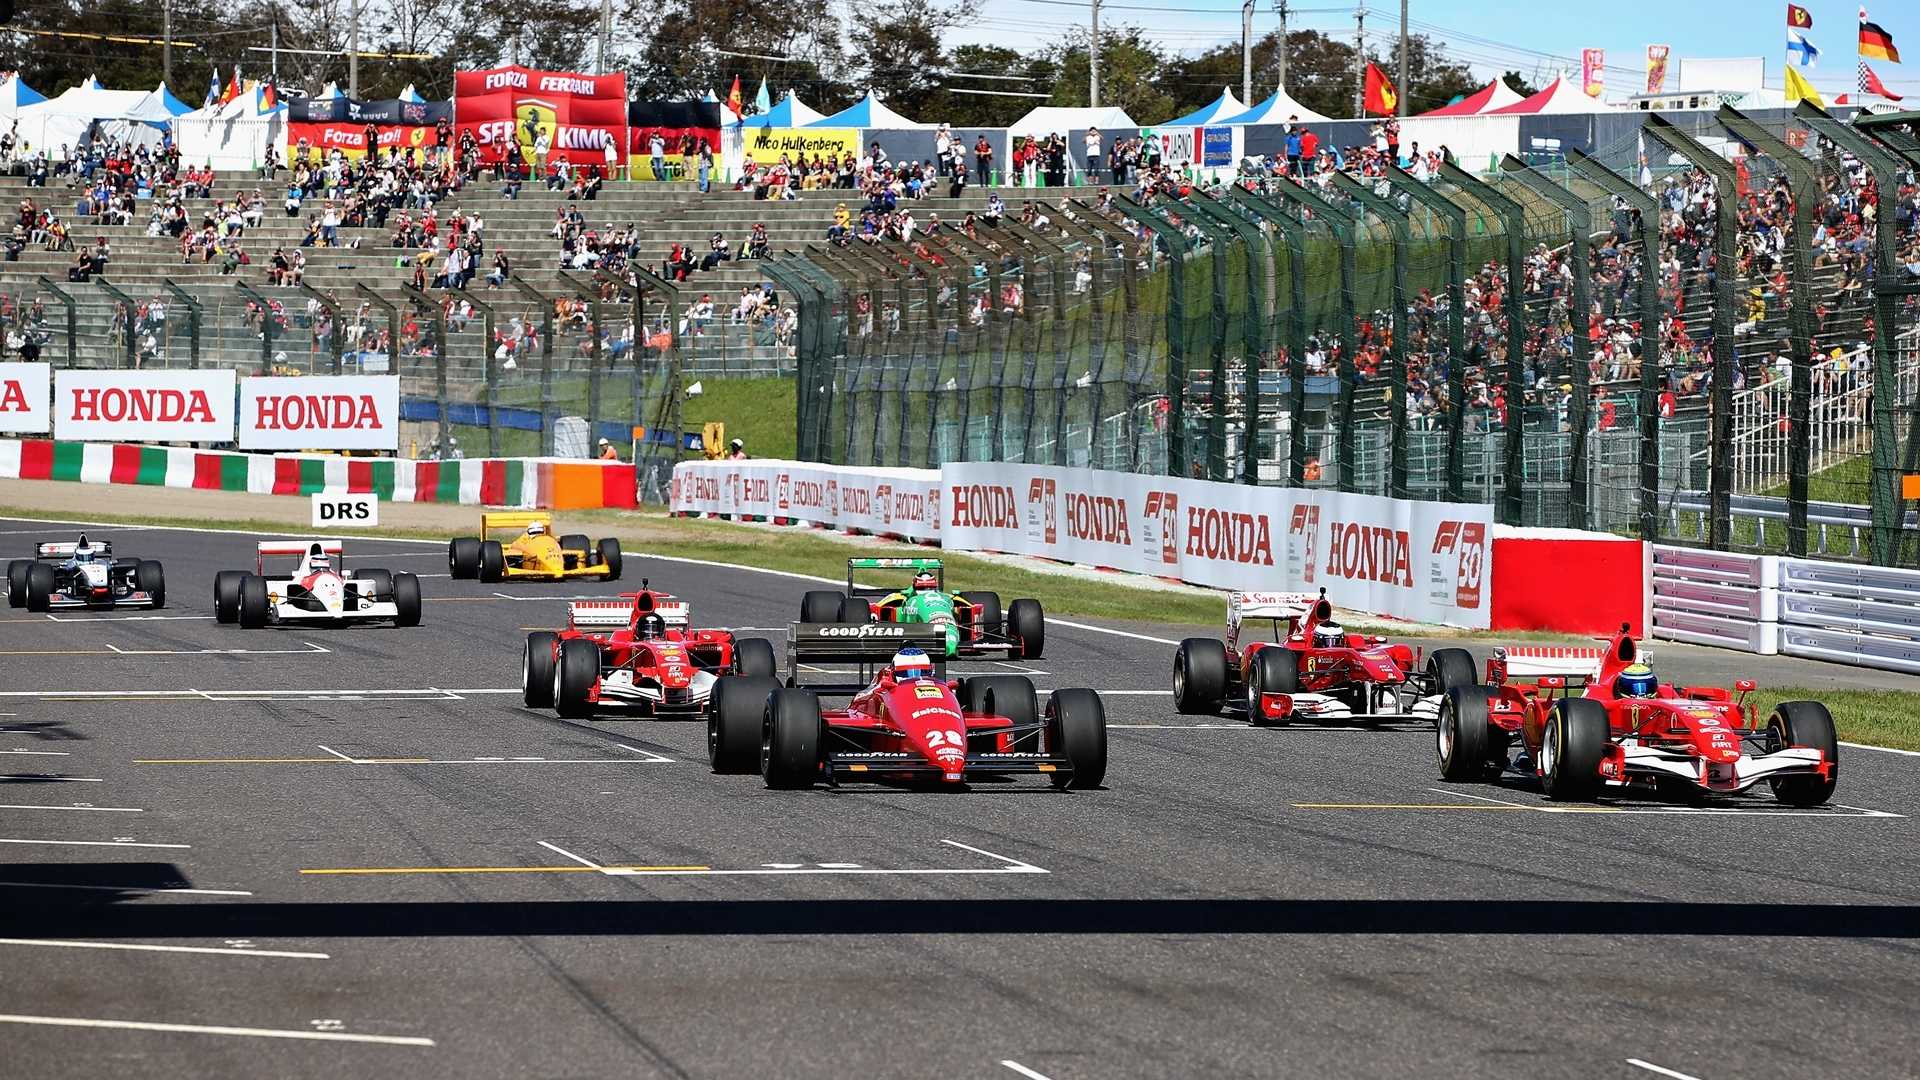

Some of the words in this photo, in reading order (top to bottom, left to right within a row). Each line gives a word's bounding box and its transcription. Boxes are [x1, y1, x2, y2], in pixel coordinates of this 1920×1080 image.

[486, 71, 528, 90] FORZA
[539, 76, 595, 96] FERRARI
[324, 129, 363, 145] Forza
[754, 135, 779, 150] Nico
[0, 380, 31, 412] A
[71, 388, 216, 423] HONDA
[255, 395, 383, 430] HONDA
[319, 501, 370, 520] DRS
[951, 485, 1019, 529] HONDA
[1065, 493, 1132, 545] HONDA
[1186, 506, 1274, 566] HONDA
[1326, 522, 1413, 587] HONDA
[925, 730, 964, 749] 28
